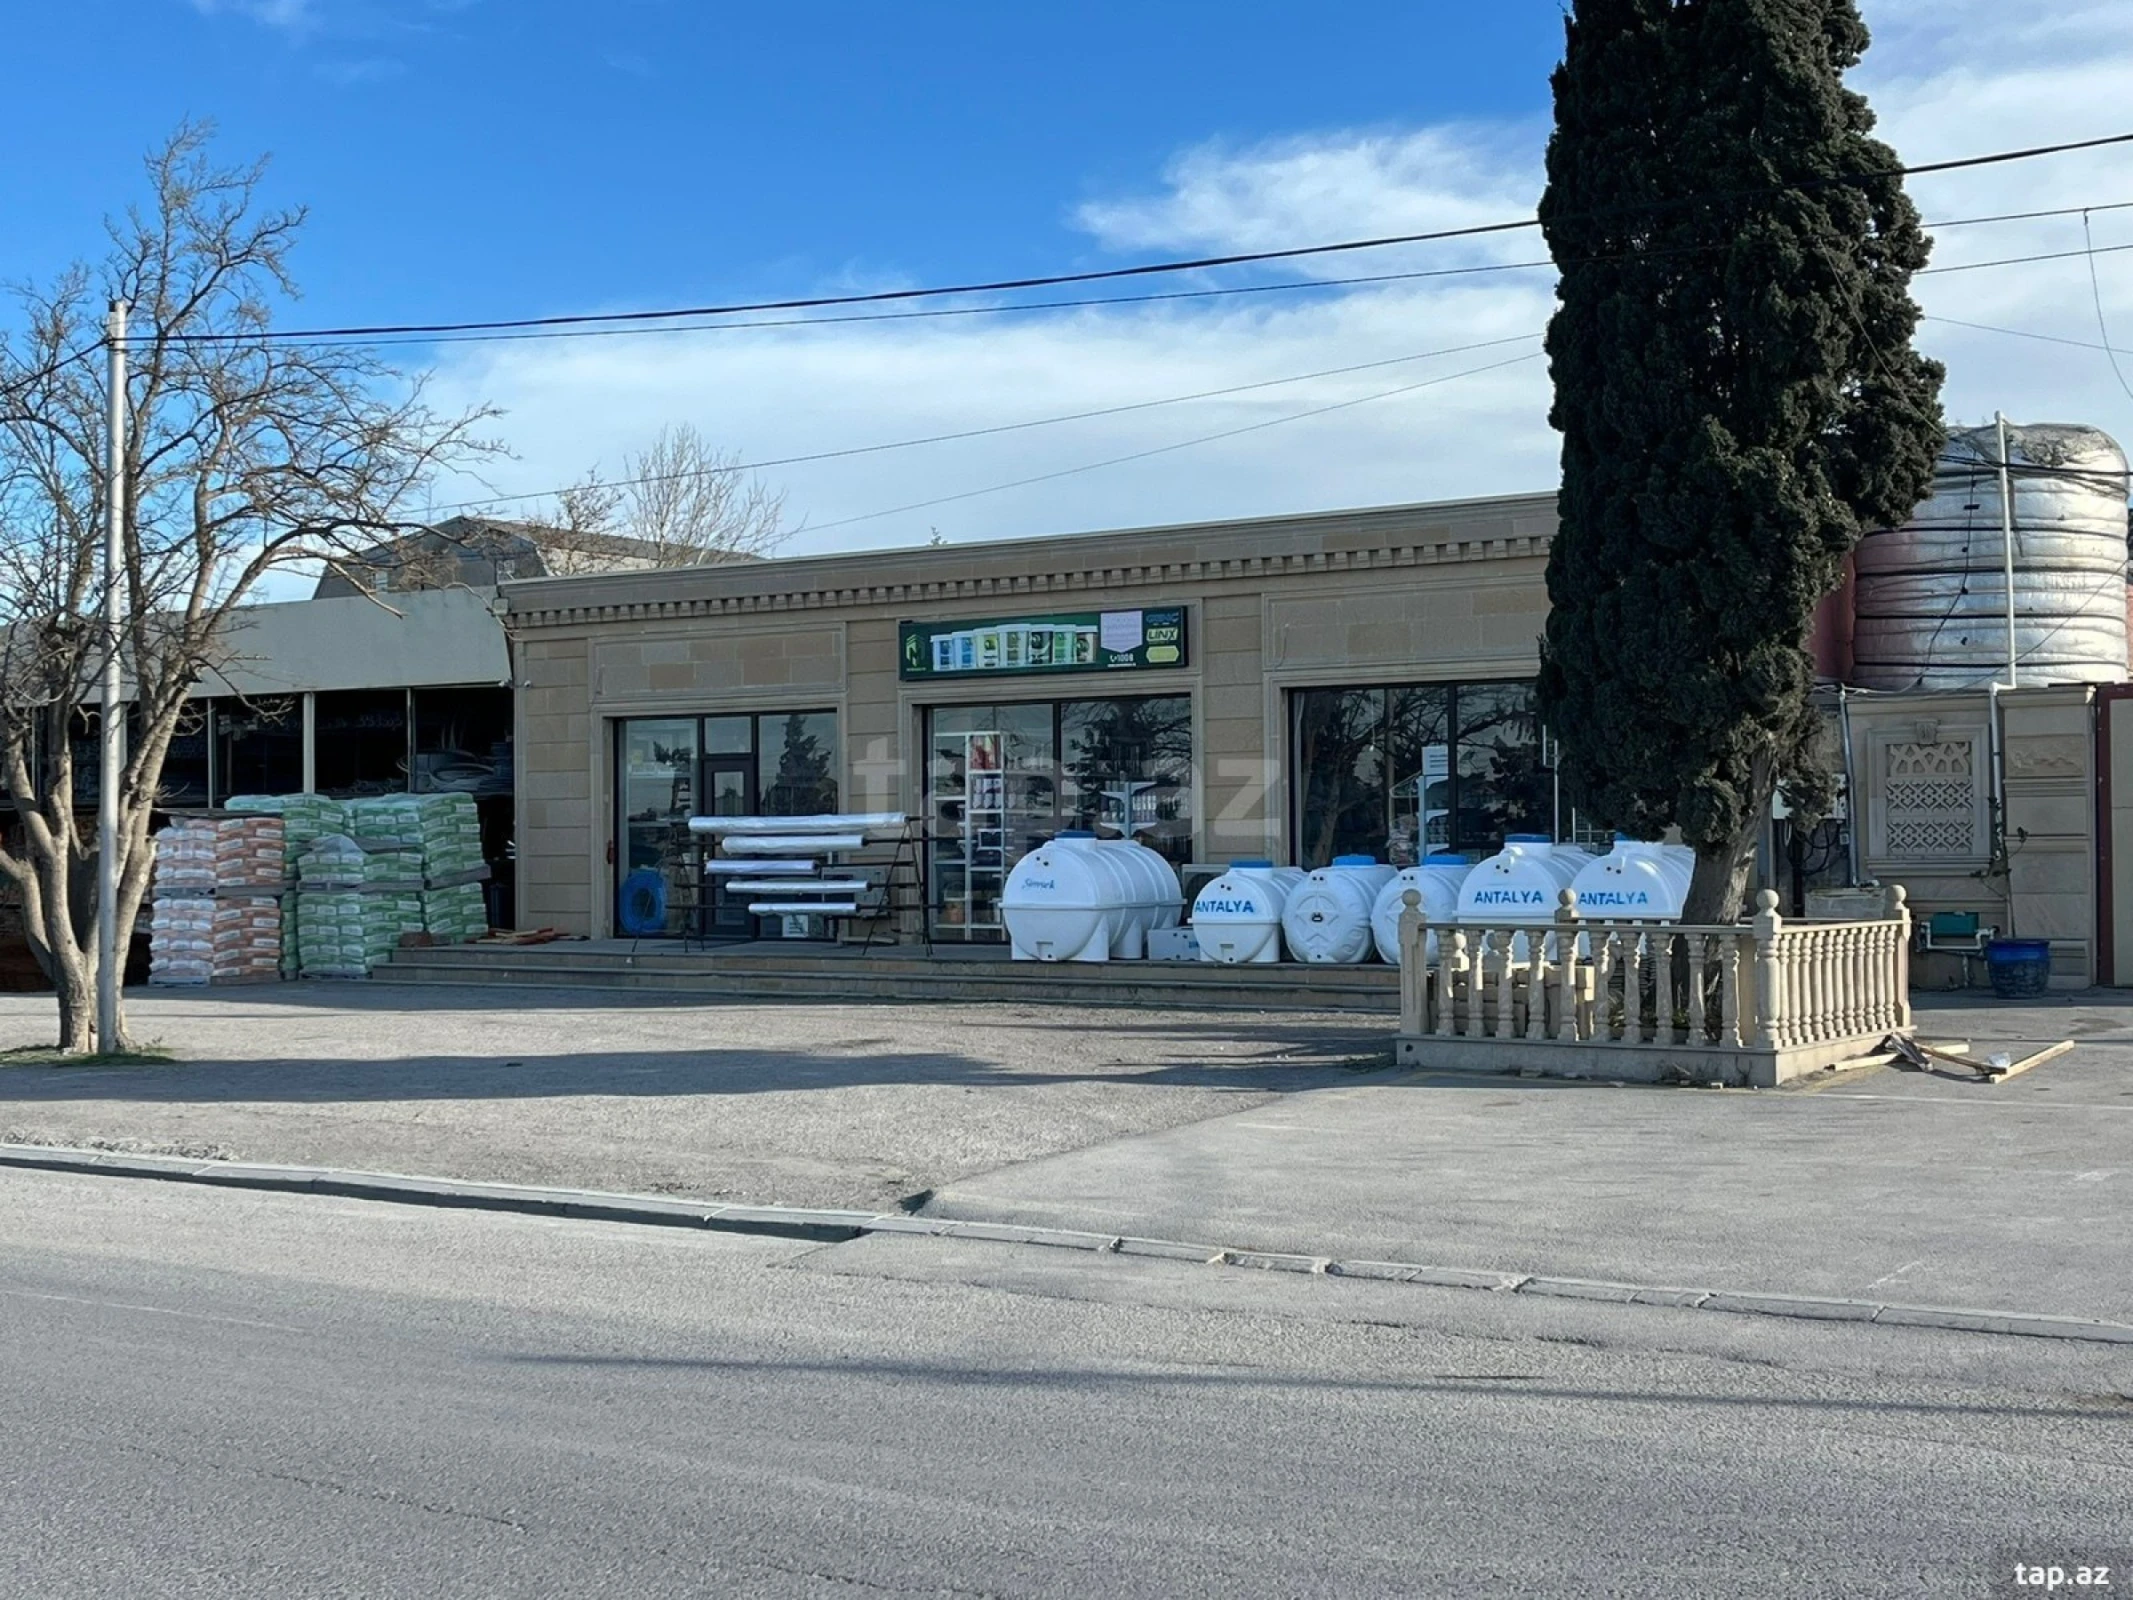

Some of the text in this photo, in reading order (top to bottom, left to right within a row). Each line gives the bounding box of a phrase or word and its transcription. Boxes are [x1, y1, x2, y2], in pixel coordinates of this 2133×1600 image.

[1473, 890, 1544, 904] ANTALYA
[1578, 891, 1649, 905] ANTALYA
[1194, 900, 1254, 913] ANTALYA
